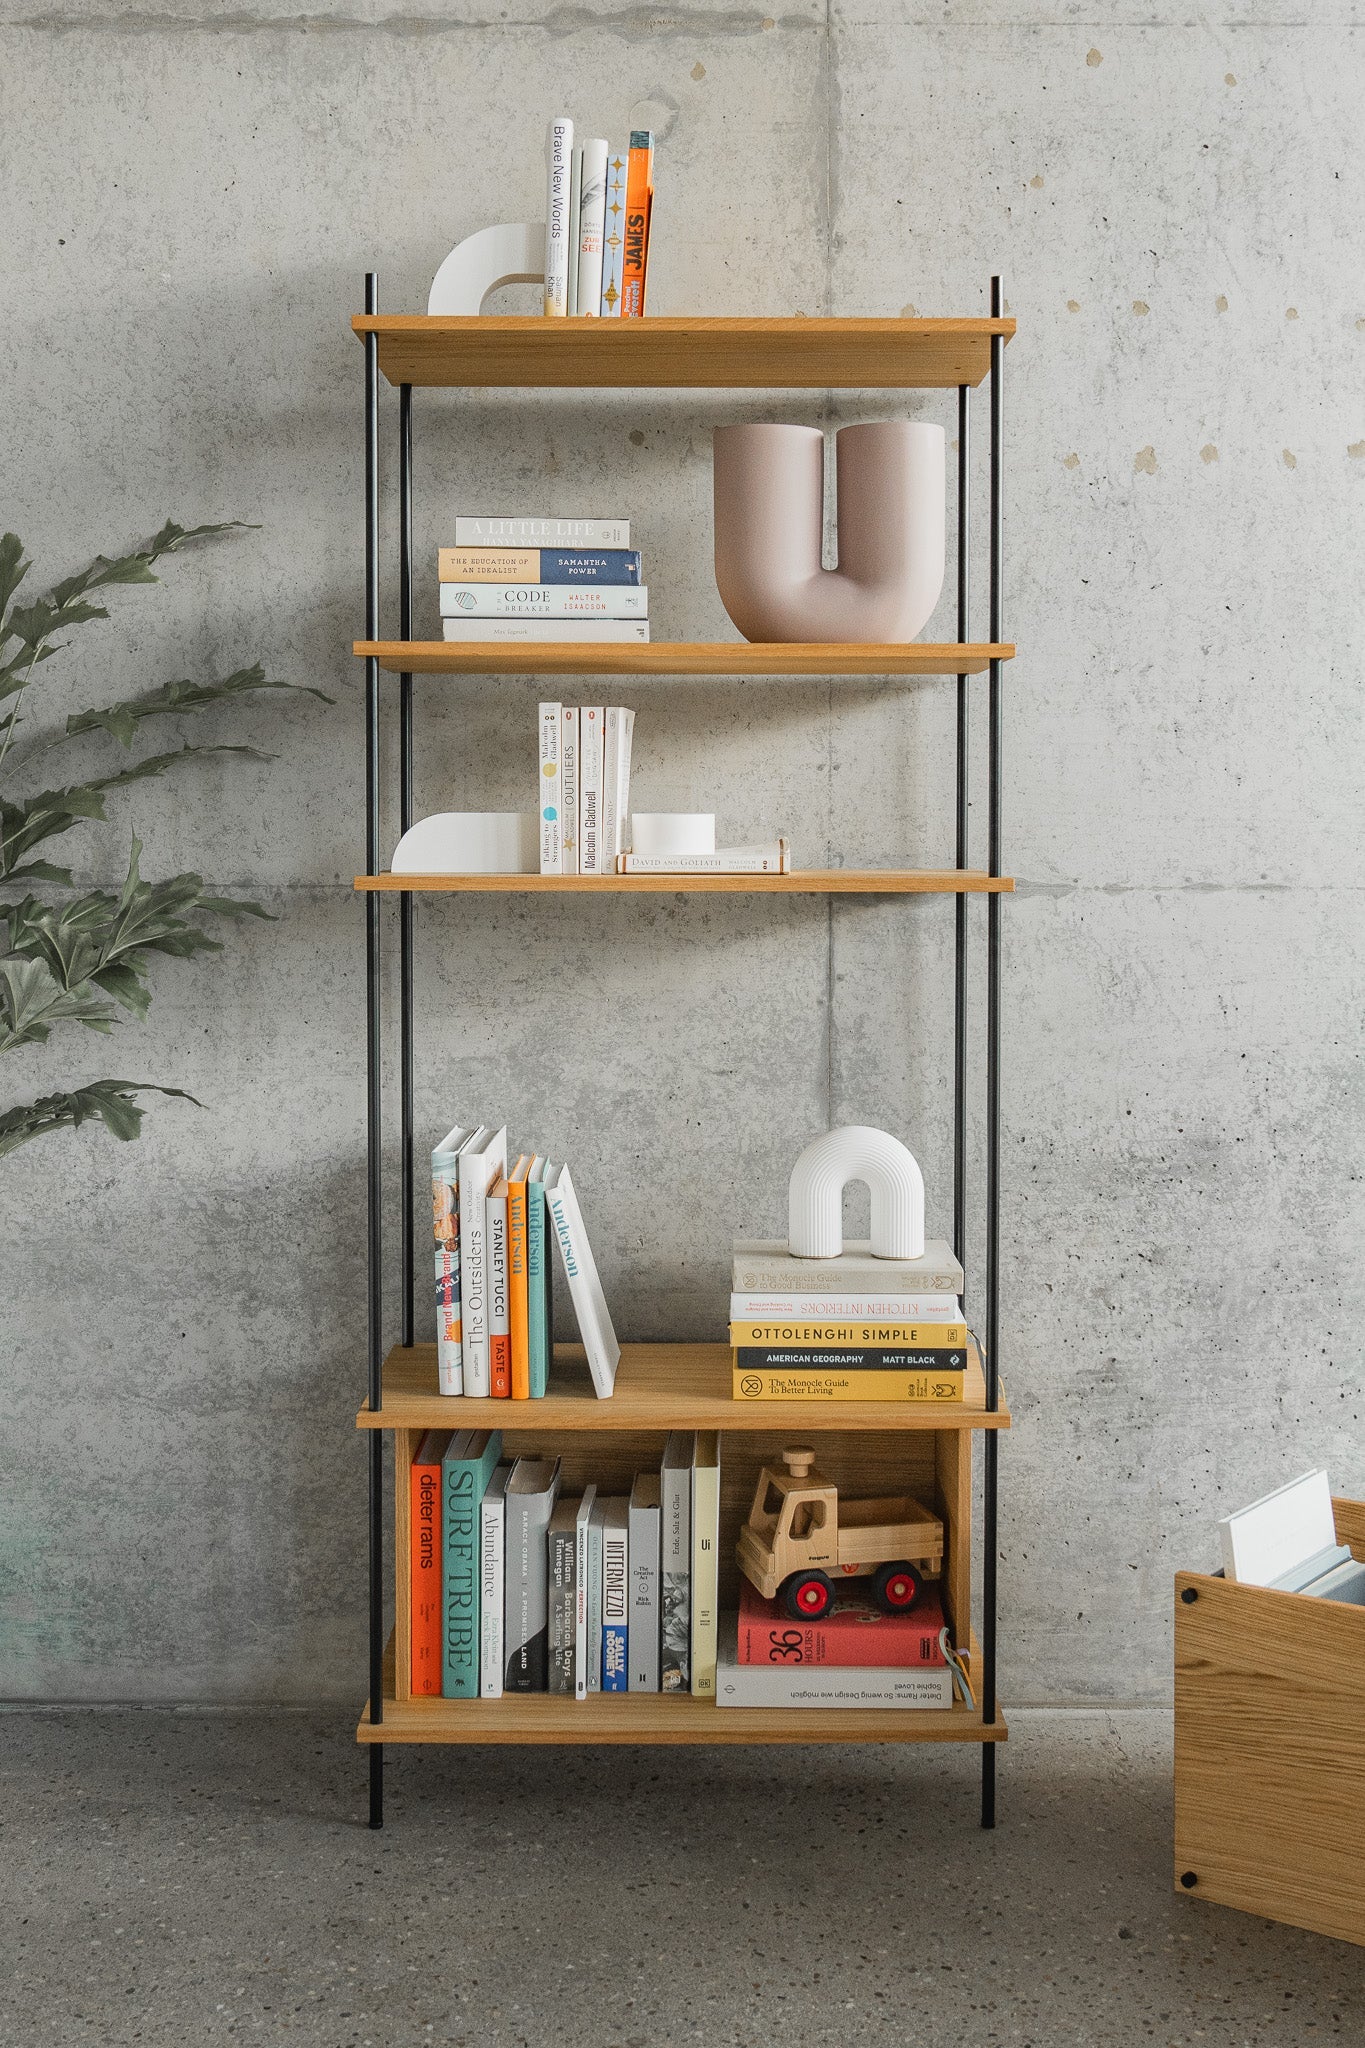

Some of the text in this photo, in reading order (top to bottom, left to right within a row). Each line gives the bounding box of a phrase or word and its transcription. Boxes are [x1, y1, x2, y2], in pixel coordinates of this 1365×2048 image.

[553, 126, 565, 162] Brave
[552, 165, 564, 194] New
[551, 197, 564, 238] Words
[582, 244, 602, 253] SEE
[626, 214, 644, 270] JAMES
[547, 276, 555, 297] Khan
[555, 276, 563, 307] Salman
[630, 280, 640, 317] Everett
[472, 521, 595, 536] A LITTLE LIFE
[568, 567, 597, 575] POWER
[504, 590, 551, 602] CODE
[541, 725, 549, 759] Malcolm
[549, 725, 557, 760] Gladwell
[564, 745, 575, 805] OUTLIERS
[584, 791, 596, 828] Gladwell
[543, 824, 552, 864] Talking to
[551, 824, 560, 863] Strangers
[584, 832, 596, 869] Malcolm
[606, 829, 614, 856] TIPPING
[632, 858, 661, 866] DAVID
[510, 1193, 524, 1275] Anderson
[529, 1194, 542, 1277] Anderson
[552, 1198, 580, 1278] Anderson
[493, 1219, 504, 1318] STANLEY TUCCI
[760, 1274, 841, 1283] The Monocle Guide
[442, 1253, 453, 1342] Brand New Brand
[467, 1230, 484, 1348] The Outsiders
[769, 1282, 793, 1290] Good
[795, 1282, 831, 1290] Business
[800, 1303, 919, 1315] KITCHEN INTERIORS
[751, 1328, 918, 1341] OTTOLENGHI SIMPLE
[495, 1341, 505, 1373] TASTE
[766, 1354, 864, 1364] AMERICAN GEOGRAPHY
[882, 1356, 936, 1365] MATT BLACK
[769, 1378, 849, 1387] The Monocle Guide
[769, 1386, 833, 1396] To Better Living
[672, 1494, 680, 1510] Glut
[420, 1474, 434, 1570] dieter rams
[672, 1521, 680, 1535] Salz
[484, 1512, 499, 1598] Abundance
[672, 1536, 680, 1555] Erde,
[701, 1539, 710, 1551] Ui
[448, 1469, 474, 1671] SURF TRIBE
[554, 1538, 565, 1588] Finnegan
[564, 1540, 574, 1583] William
[606, 1541, 625, 1617] INTERMEZZO
[482, 1611, 491, 1670] Derek Thompson
[492, 1617, 500, 1633] Ezra
[554, 1613, 563, 1647] Surfing
[563, 1592, 574, 1677] Barbarian Days
[492, 1635, 500, 1654] Klein
[606, 1630, 616, 1679] ROONEY
[615, 1636, 625, 1673] SALLY
[769, 1630, 803, 1663] 36
[804, 1629, 813, 1663] HOURS
[790, 1690, 820, 1700] möglich
[834, 1691, 860, 1700] Design
[861, 1691, 882, 1700] wenig
[883, 1692, 895, 1700] So
[916, 1682, 942, 1690] Sophie
[919, 1692, 942, 1701] Dieter
